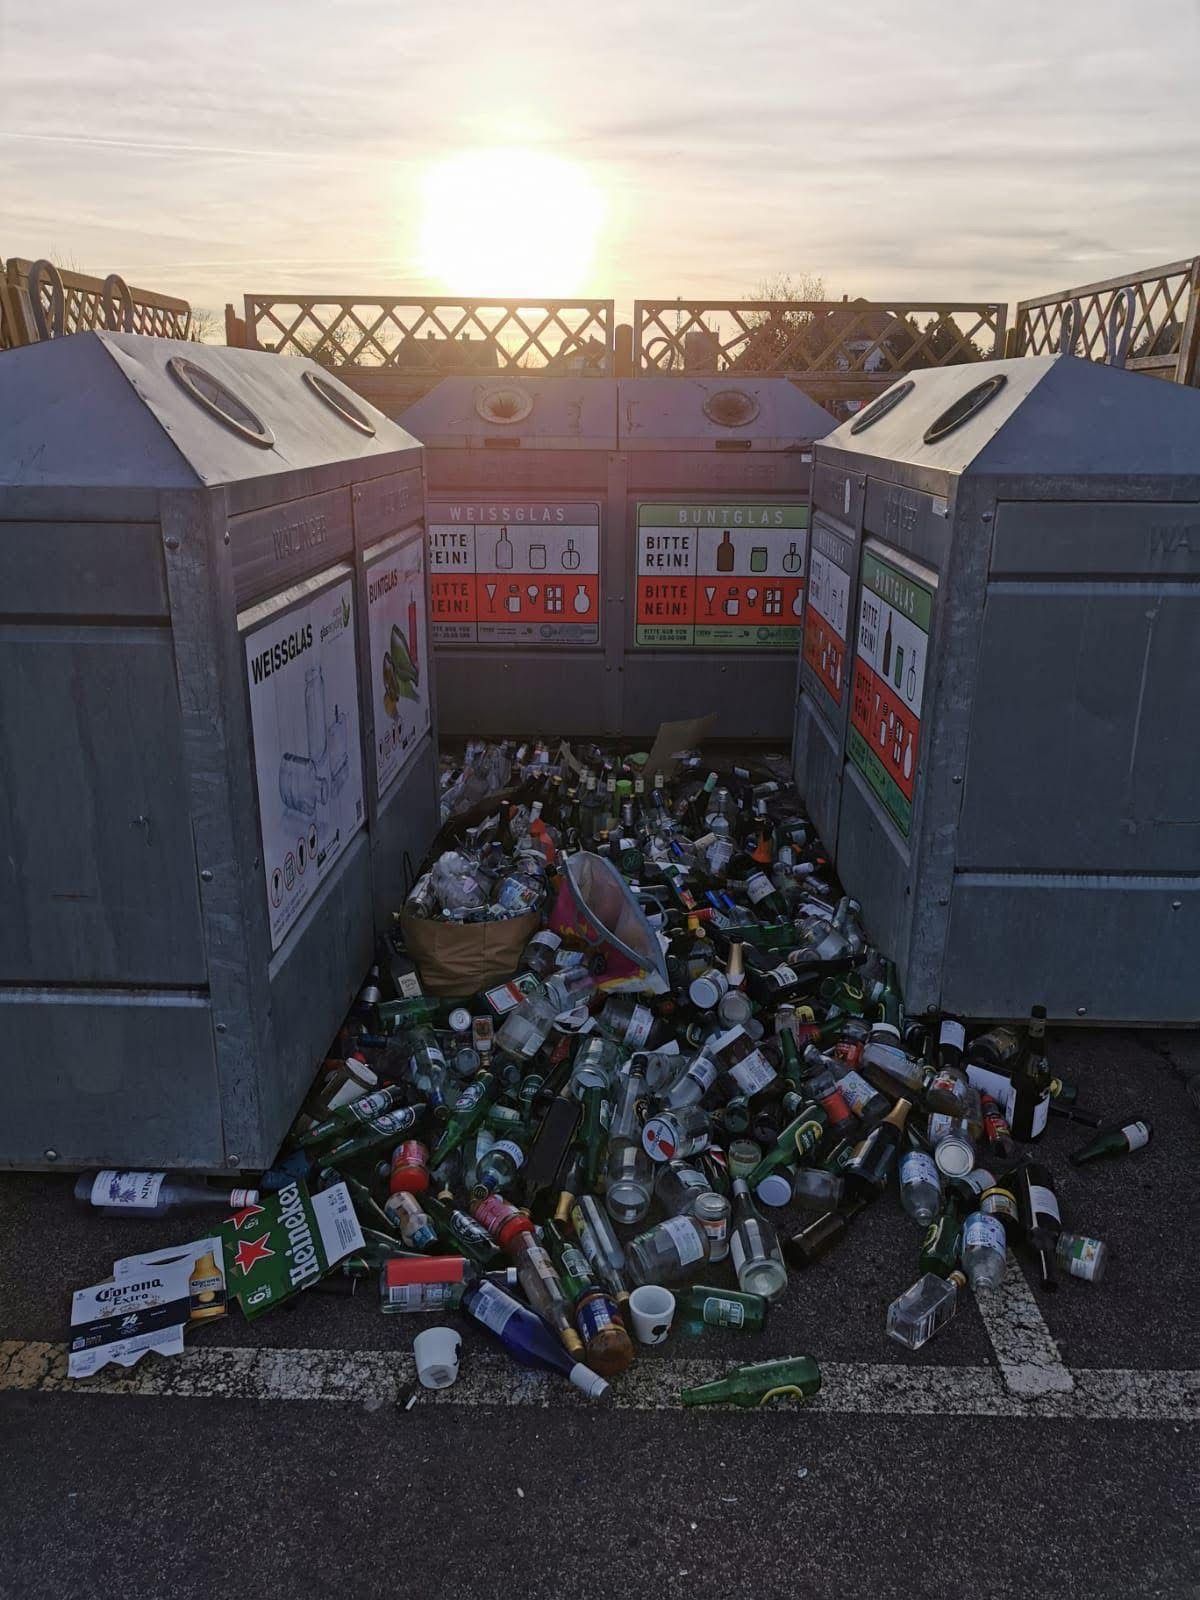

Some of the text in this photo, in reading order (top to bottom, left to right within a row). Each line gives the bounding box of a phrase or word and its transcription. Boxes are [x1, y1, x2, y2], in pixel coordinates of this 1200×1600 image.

[450, 507, 565, 521] WEISSGLAS
[679, 510, 784, 524] BUNTGLAS
[646, 537, 689, 550] BITTE
[646, 553, 689, 567] REIN!
[368, 568, 398, 604] BUNTGLAS
[431, 582, 468, 596] ITTE
[645, 585, 688, 599] BITTE
[875, 569, 915, 614] BUNTGLAS
[433, 600, 469, 613] EIN!
[645, 603, 687, 616] NEIN!
[862, 600, 878, 629] BITTE
[251, 623, 313, 685] WEISSGLAS
[141, 1172, 153, 1199] ONIN
[191, 1277, 221, 1287] Corona
[95, 1277, 162, 1303] Corona
[113, 1292, 149, 1306] Extra
